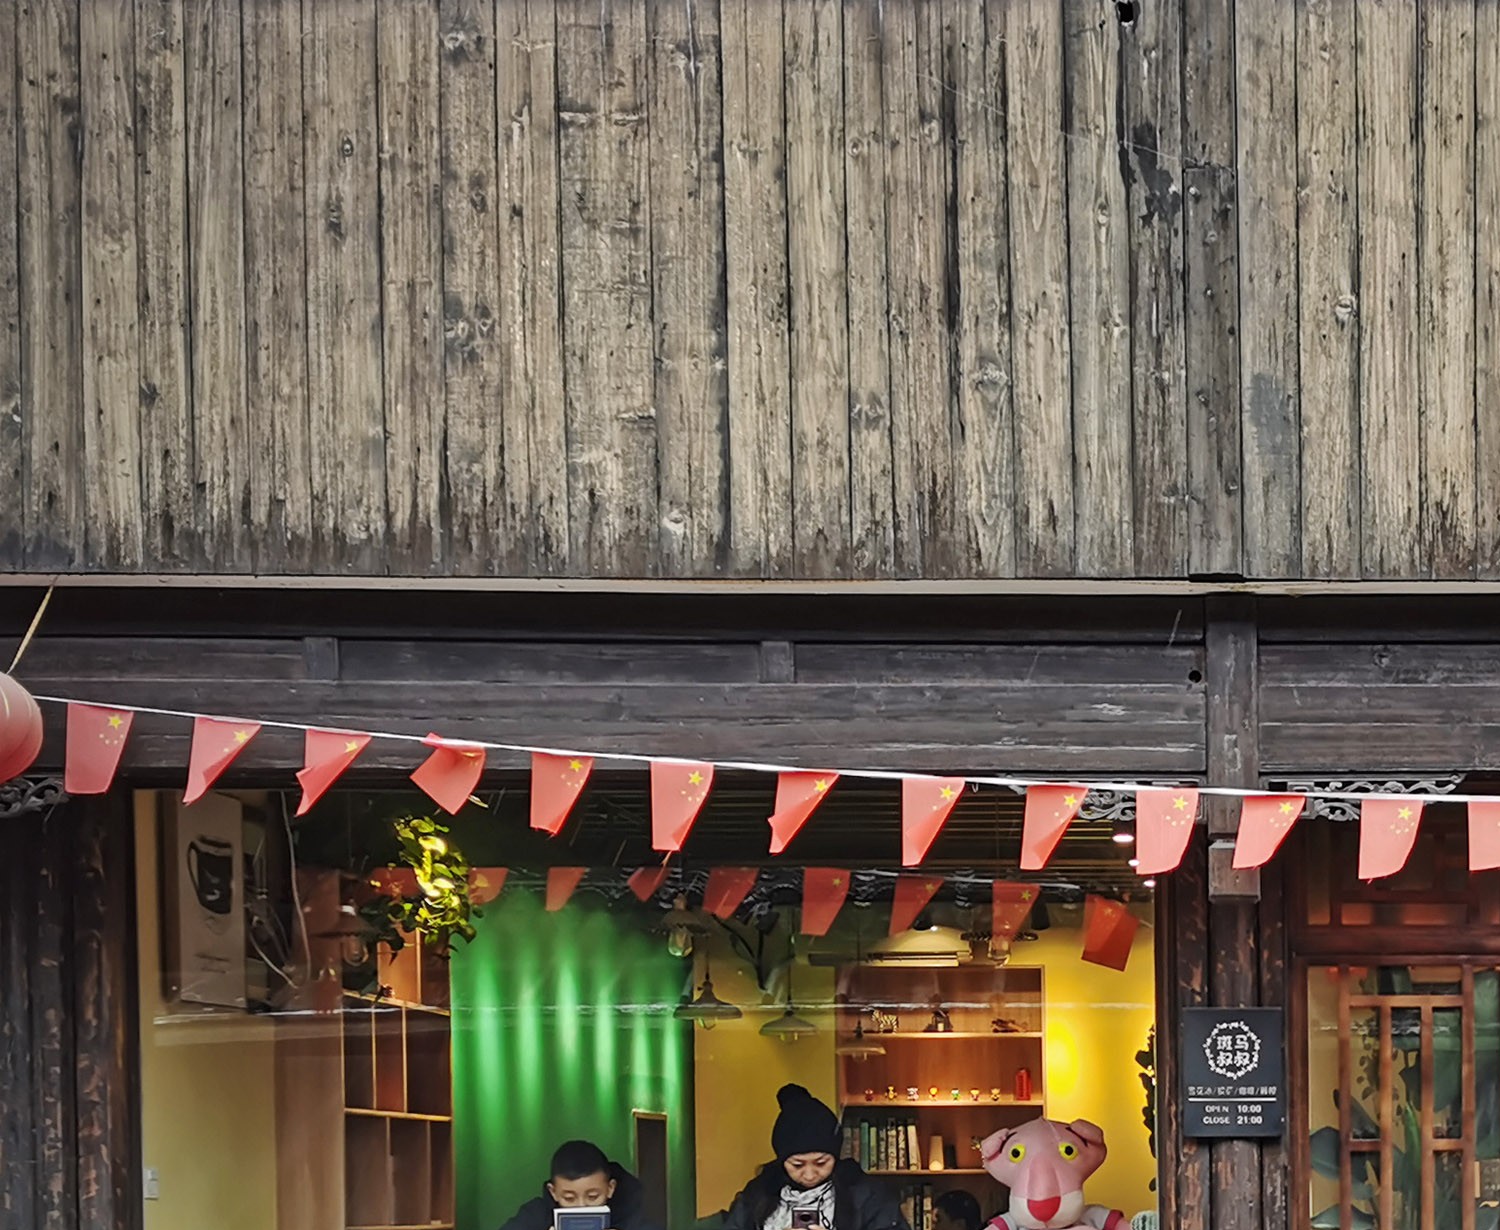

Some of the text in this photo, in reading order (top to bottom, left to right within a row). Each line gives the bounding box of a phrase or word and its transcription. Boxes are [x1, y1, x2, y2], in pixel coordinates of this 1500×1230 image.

[1205, 1104, 1262, 1114] OPEN 10:00
[1202, 1115, 1263, 1125] CLOSE 21:00
